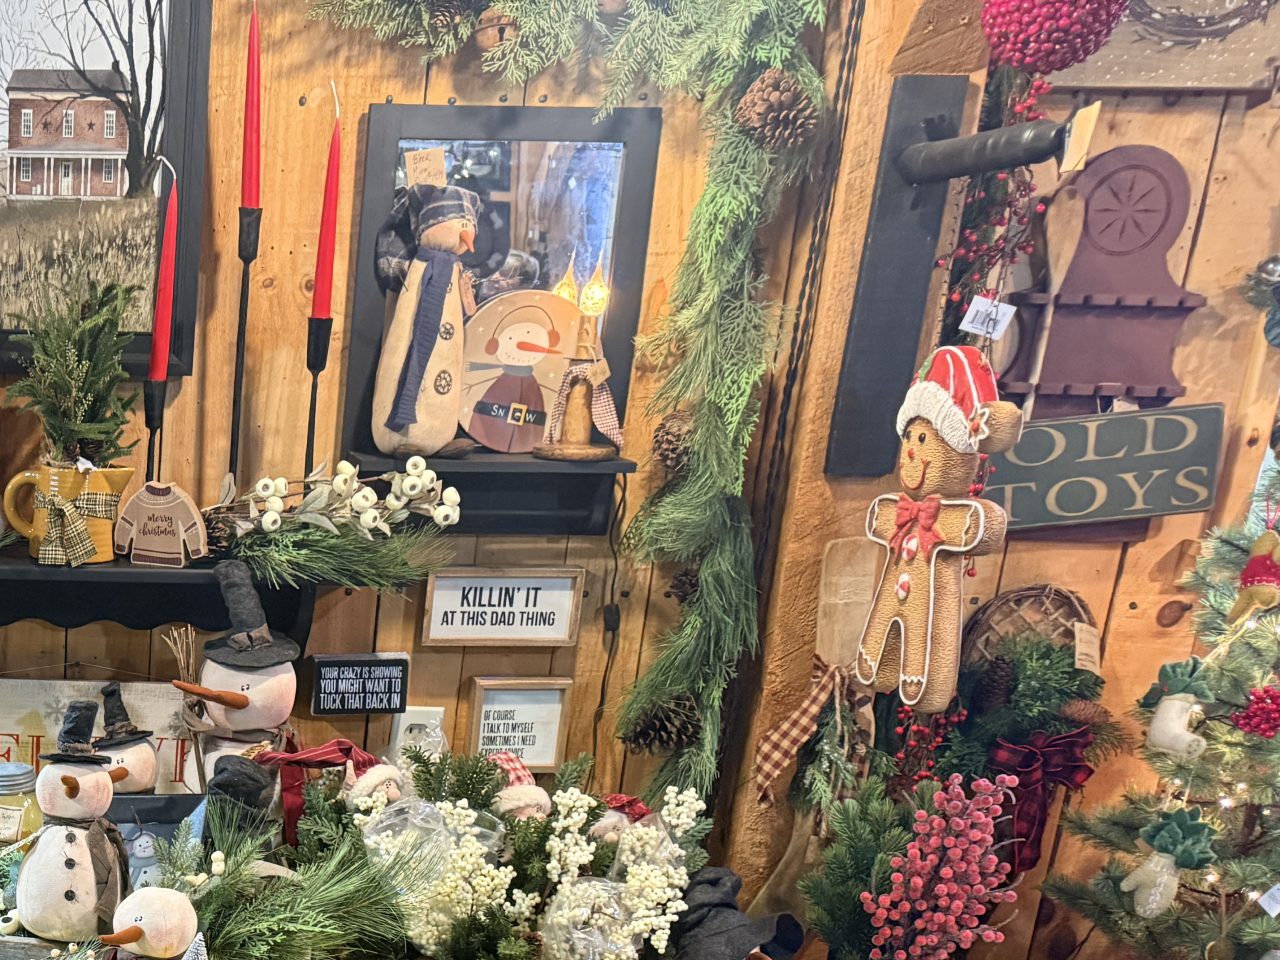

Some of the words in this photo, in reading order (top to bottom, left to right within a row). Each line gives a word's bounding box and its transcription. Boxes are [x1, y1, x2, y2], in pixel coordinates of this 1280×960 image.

[1004, 414, 1199, 467] OLD
[985, 466, 1210, 523] TOYS
[525, 587, 542, 608] IT
[441, 611, 457, 626] AT
[460, 611, 487, 626] THIS
[490, 611, 516, 626] DAD
[519, 611, 556, 626] THING
[320, 666, 339, 679] YOUR
[340, 666, 362, 679] CRAZY
[362, 666, 370, 679] IS
[370, 665, 403, 678] SHOWING
[320, 679, 336, 693] YOU
[338, 679, 364, 693] MIGHT
[365, 679, 389, 693] WANT
[391, 678, 401, 692] TO
[320, 693, 342, 709] TUCK
[344, 693, 365, 709] THAT
[365, 693, 389, 709] BACK
[390, 693, 401, 709] IN
[484, 710, 492, 721] OF
[493, 709, 517, 721] COURSE
[487, 722, 501, 733] TALK
[502, 722, 510, 733] TO
[510, 722, 535, 733] MYSELF
[481, 735, 516, 746] SOMETIMES
[521, 735, 536, 746] NEED
